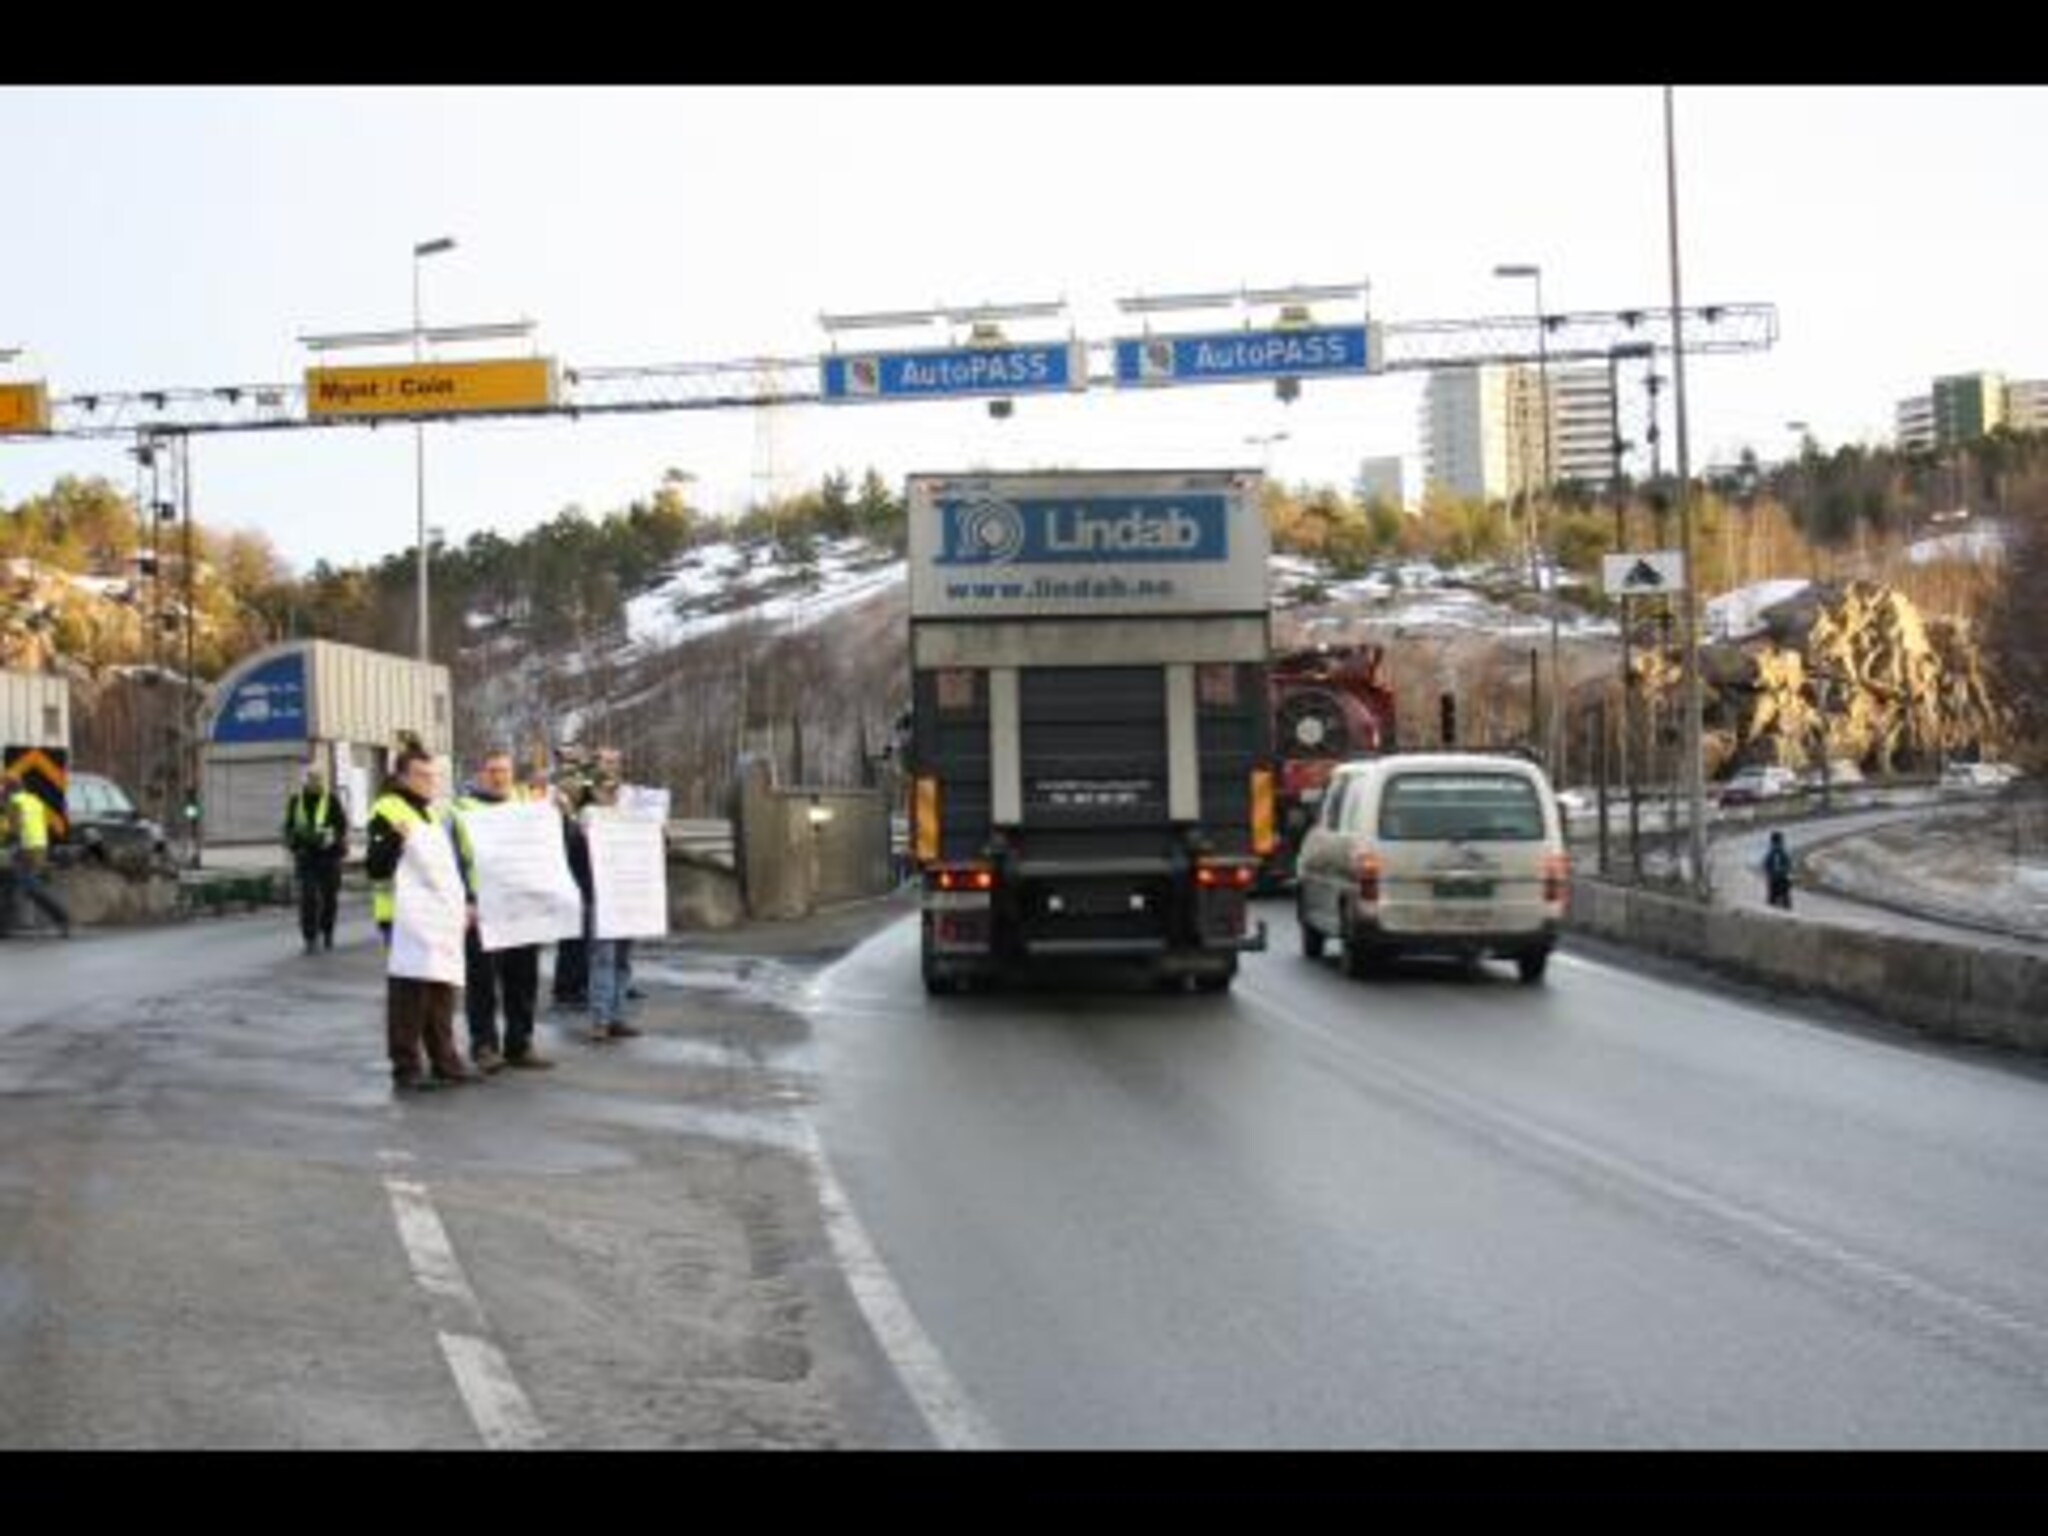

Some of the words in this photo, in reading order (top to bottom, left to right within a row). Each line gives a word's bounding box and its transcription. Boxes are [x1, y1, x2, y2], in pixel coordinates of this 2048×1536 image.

[902, 351, 1049, 386] AutoPASS
[1195, 335, 1346, 370] AutoPASS
[1045, 505, 1198, 551] Lindab
